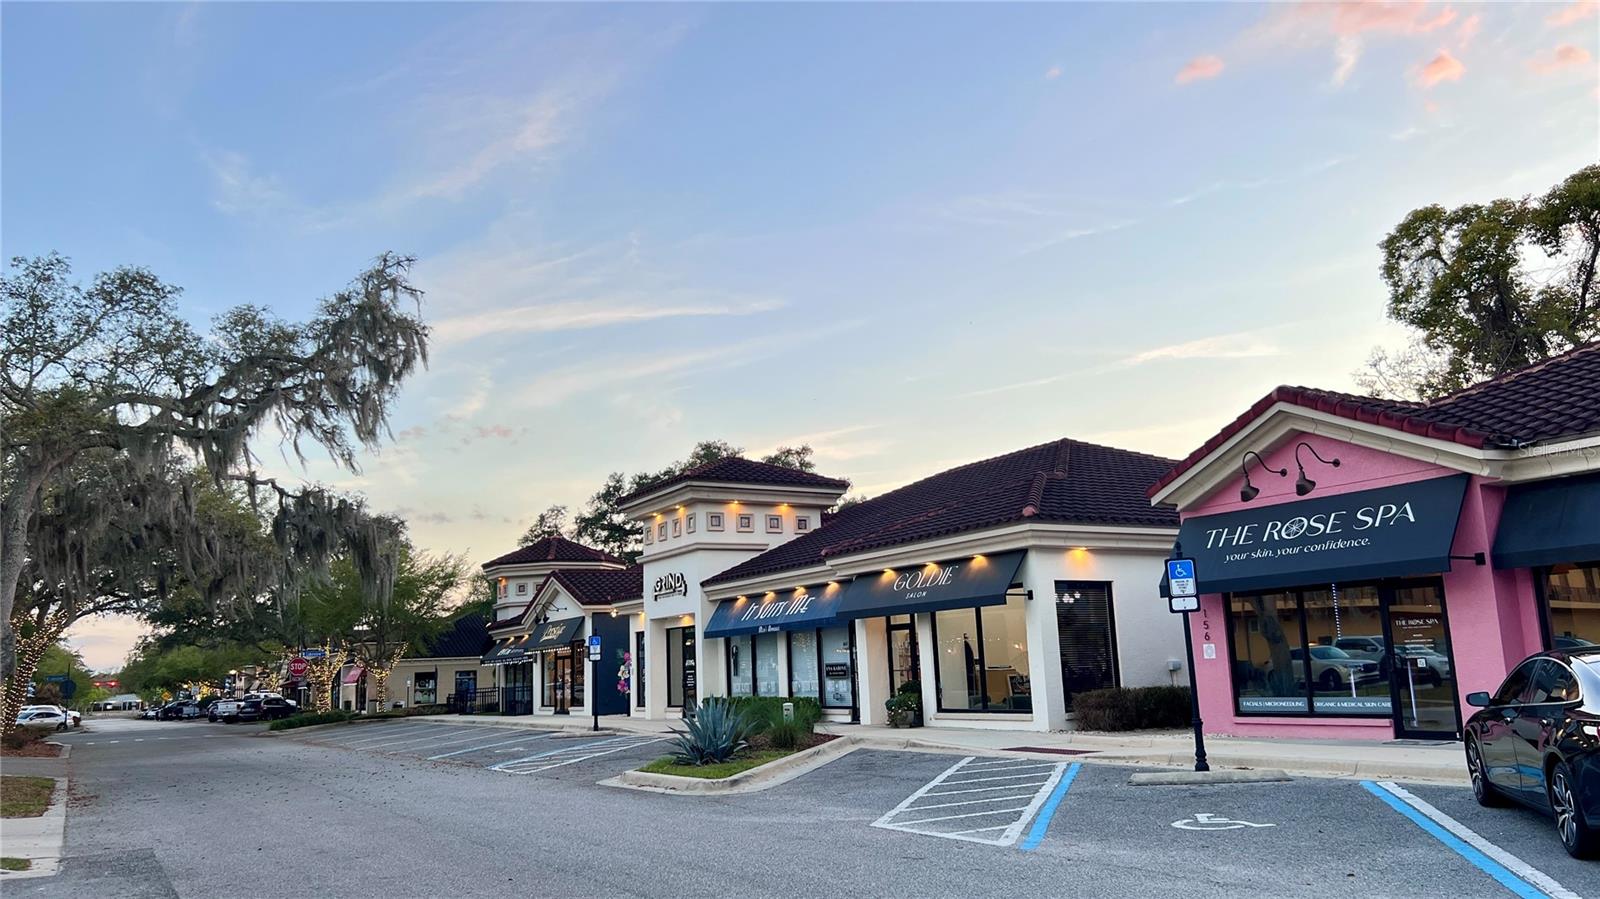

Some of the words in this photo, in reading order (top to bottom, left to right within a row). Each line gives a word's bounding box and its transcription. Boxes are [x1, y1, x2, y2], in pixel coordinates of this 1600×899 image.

[1205, 523, 1258, 549] THE
[1262, 511, 1347, 542] ROSE
[1352, 501, 1415, 530] SPA
[1223, 552, 1249, 564] your
[1250, 546, 1273, 559] skin.
[1274, 545, 1302, 558] your
[1303, 536, 1370, 553] confidence.
[655, 573, 685, 592] GRIND
[893, 565, 959, 591] GOLDIE
[905, 591, 927, 599] SALON
[290, 663, 307, 671] STOP
